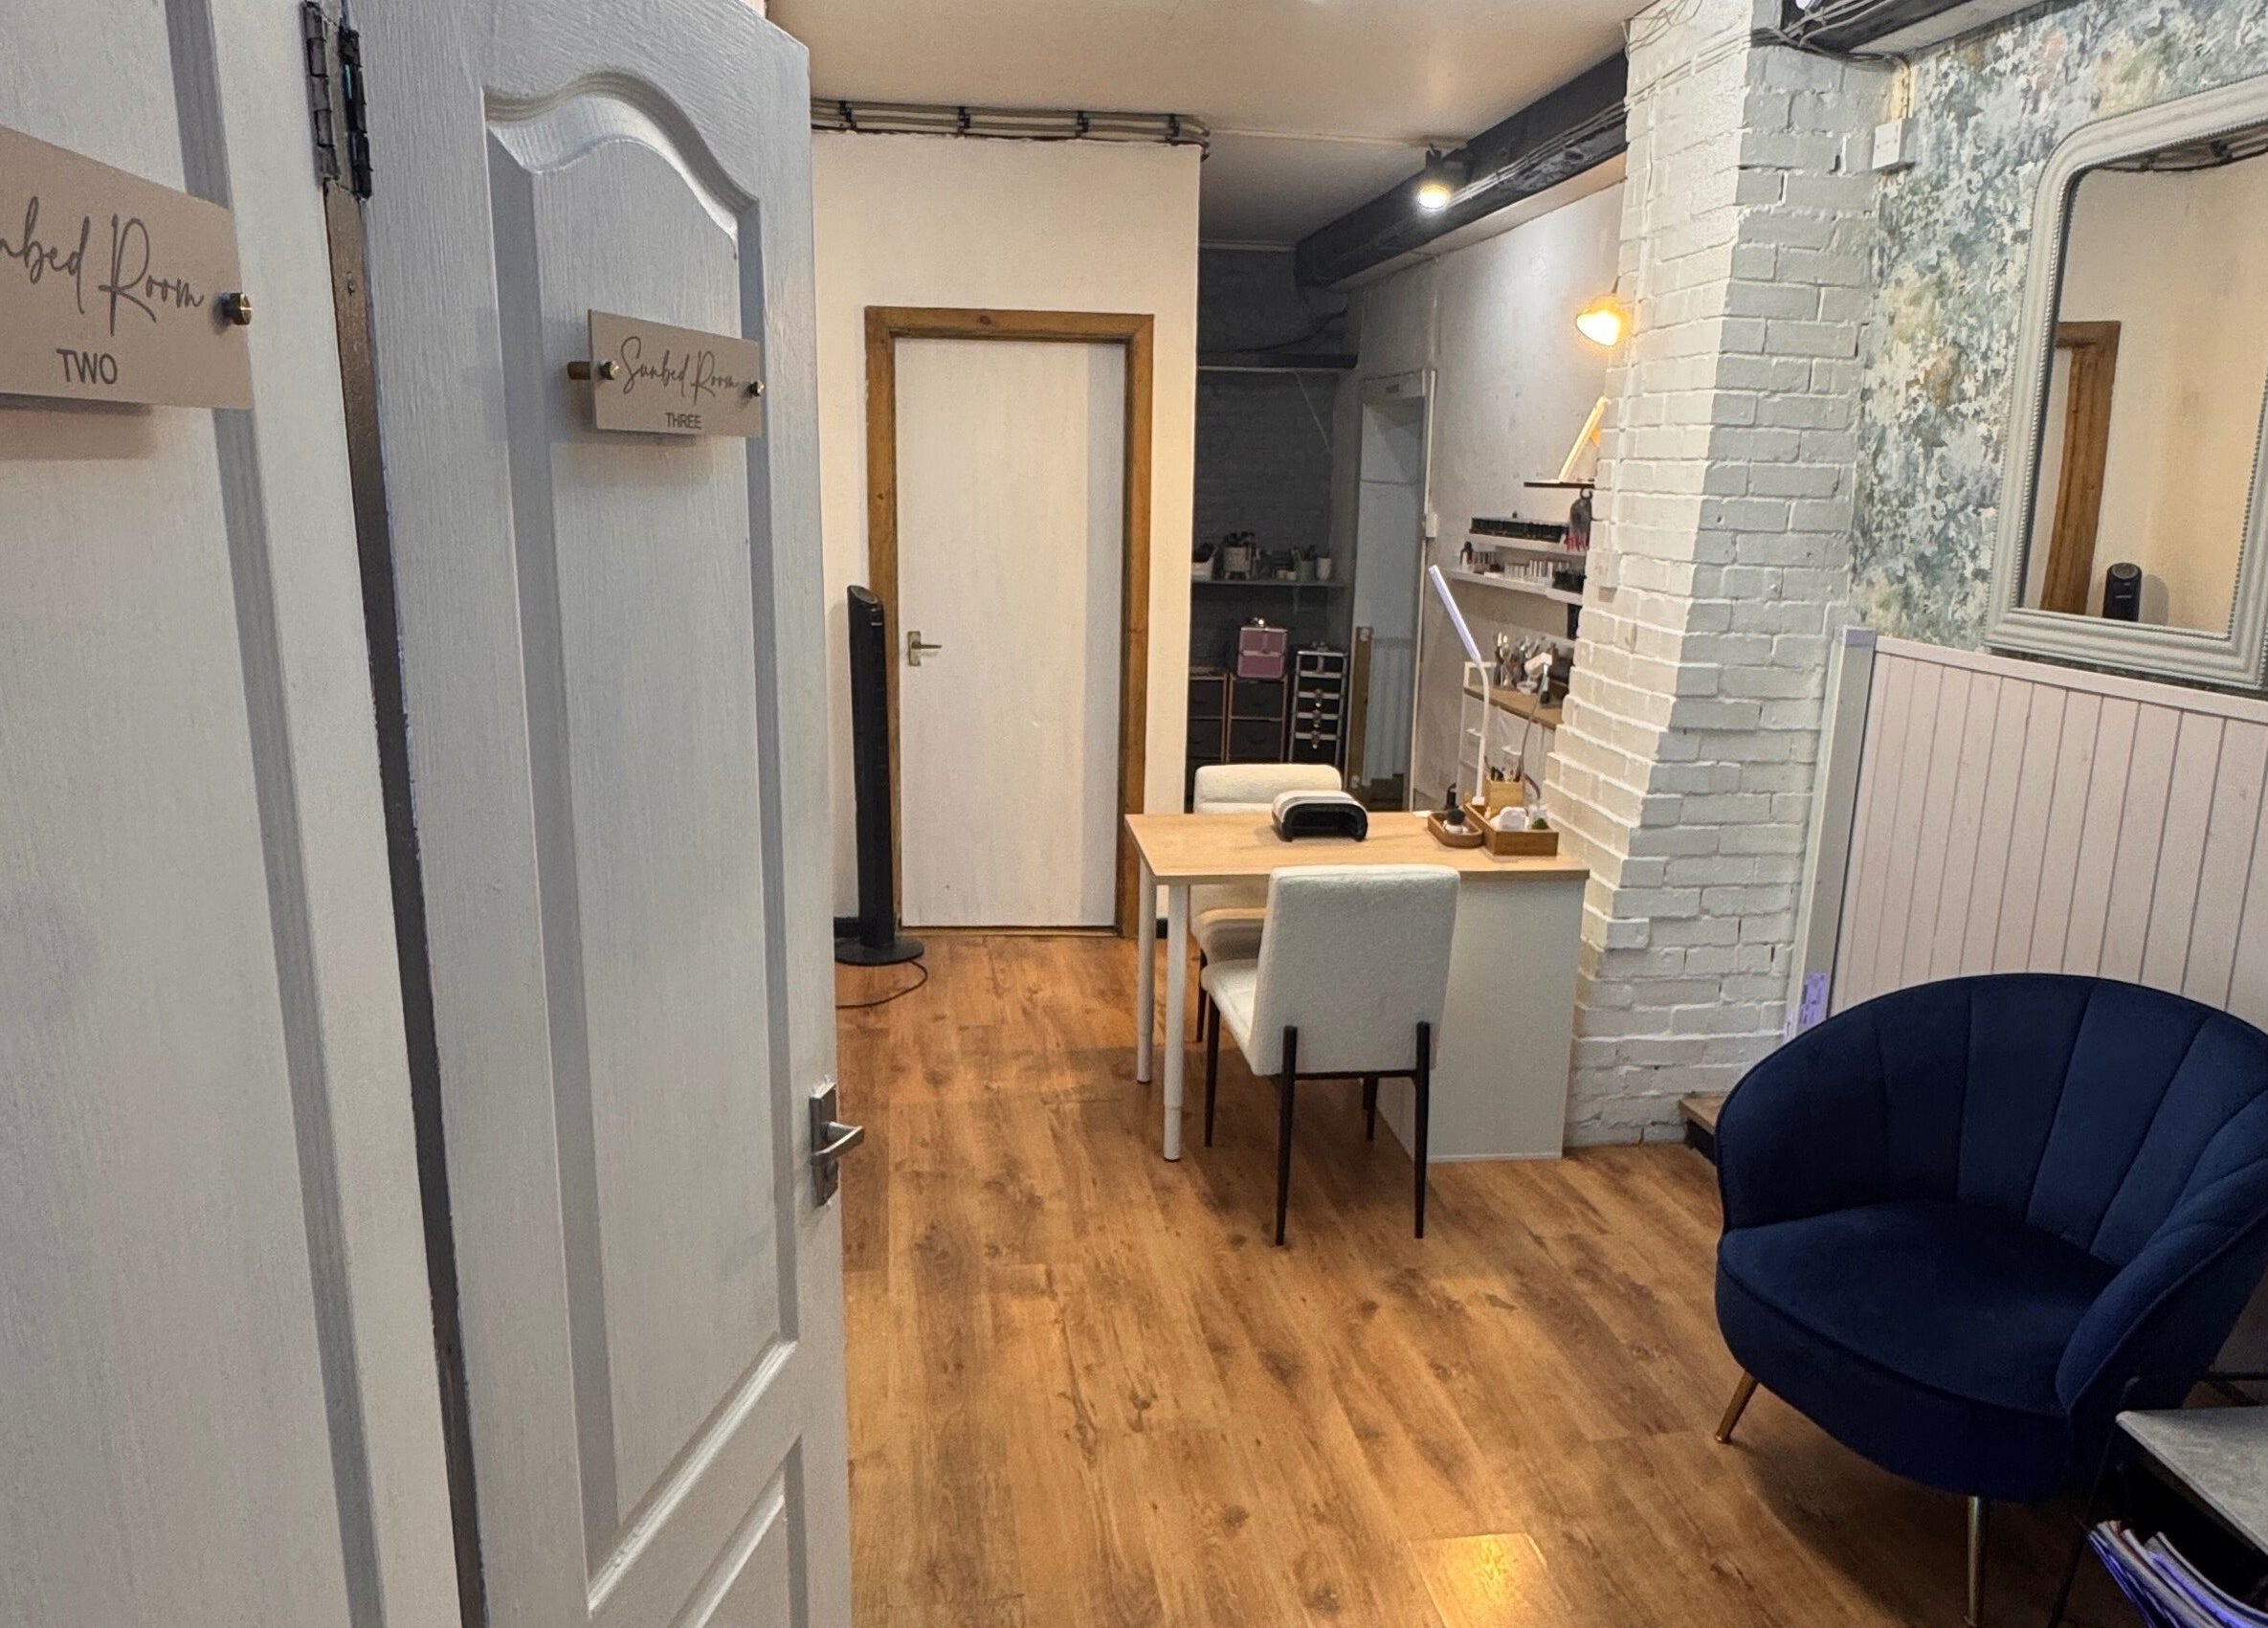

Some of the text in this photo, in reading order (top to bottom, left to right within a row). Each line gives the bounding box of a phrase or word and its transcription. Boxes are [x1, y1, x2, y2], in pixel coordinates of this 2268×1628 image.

[98, 213, 204, 336] Room
[56, 347, 118, 385] TWO
[620, 335, 739, 406] Sunbed Room
[665, 413, 702, 431] THREE
